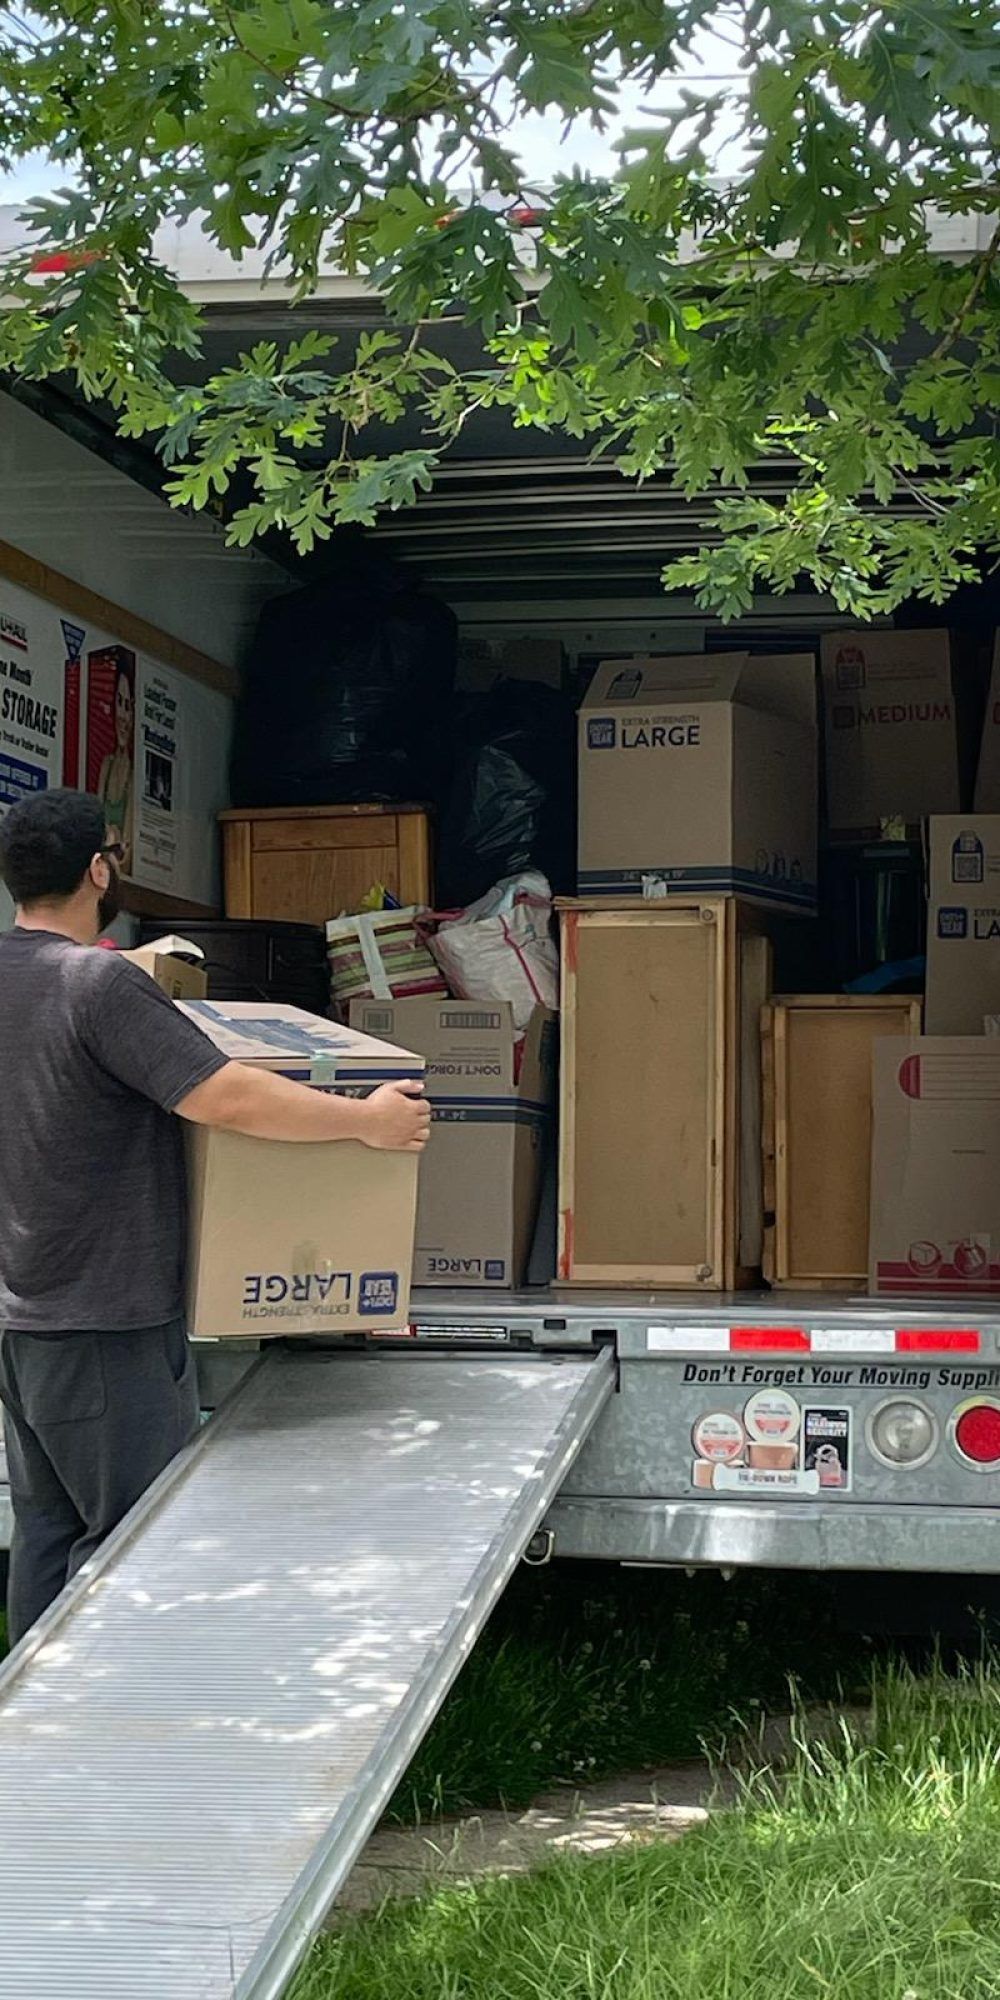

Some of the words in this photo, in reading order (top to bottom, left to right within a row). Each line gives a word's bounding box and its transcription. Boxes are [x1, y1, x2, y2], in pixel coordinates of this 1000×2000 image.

[2, 688, 58, 738] STORAGE
[858, 702, 951, 725] MEDIUM
[621, 725, 700, 748] LARGE
[466, 1064, 501, 1076] DON'T
[427, 1258, 481, 1272] LARGE
[243, 1272, 352, 1304] LARGE
[243, 1304, 309, 1319] STRENGTH
[312, 1303, 350, 1316] EXTRA
[683, 1364, 735, 1383] Don't
[741, 1365, 805, 1387] Forget
[810, 1366, 854, 1384] Your
[859, 1367, 931, 1389] Moving
